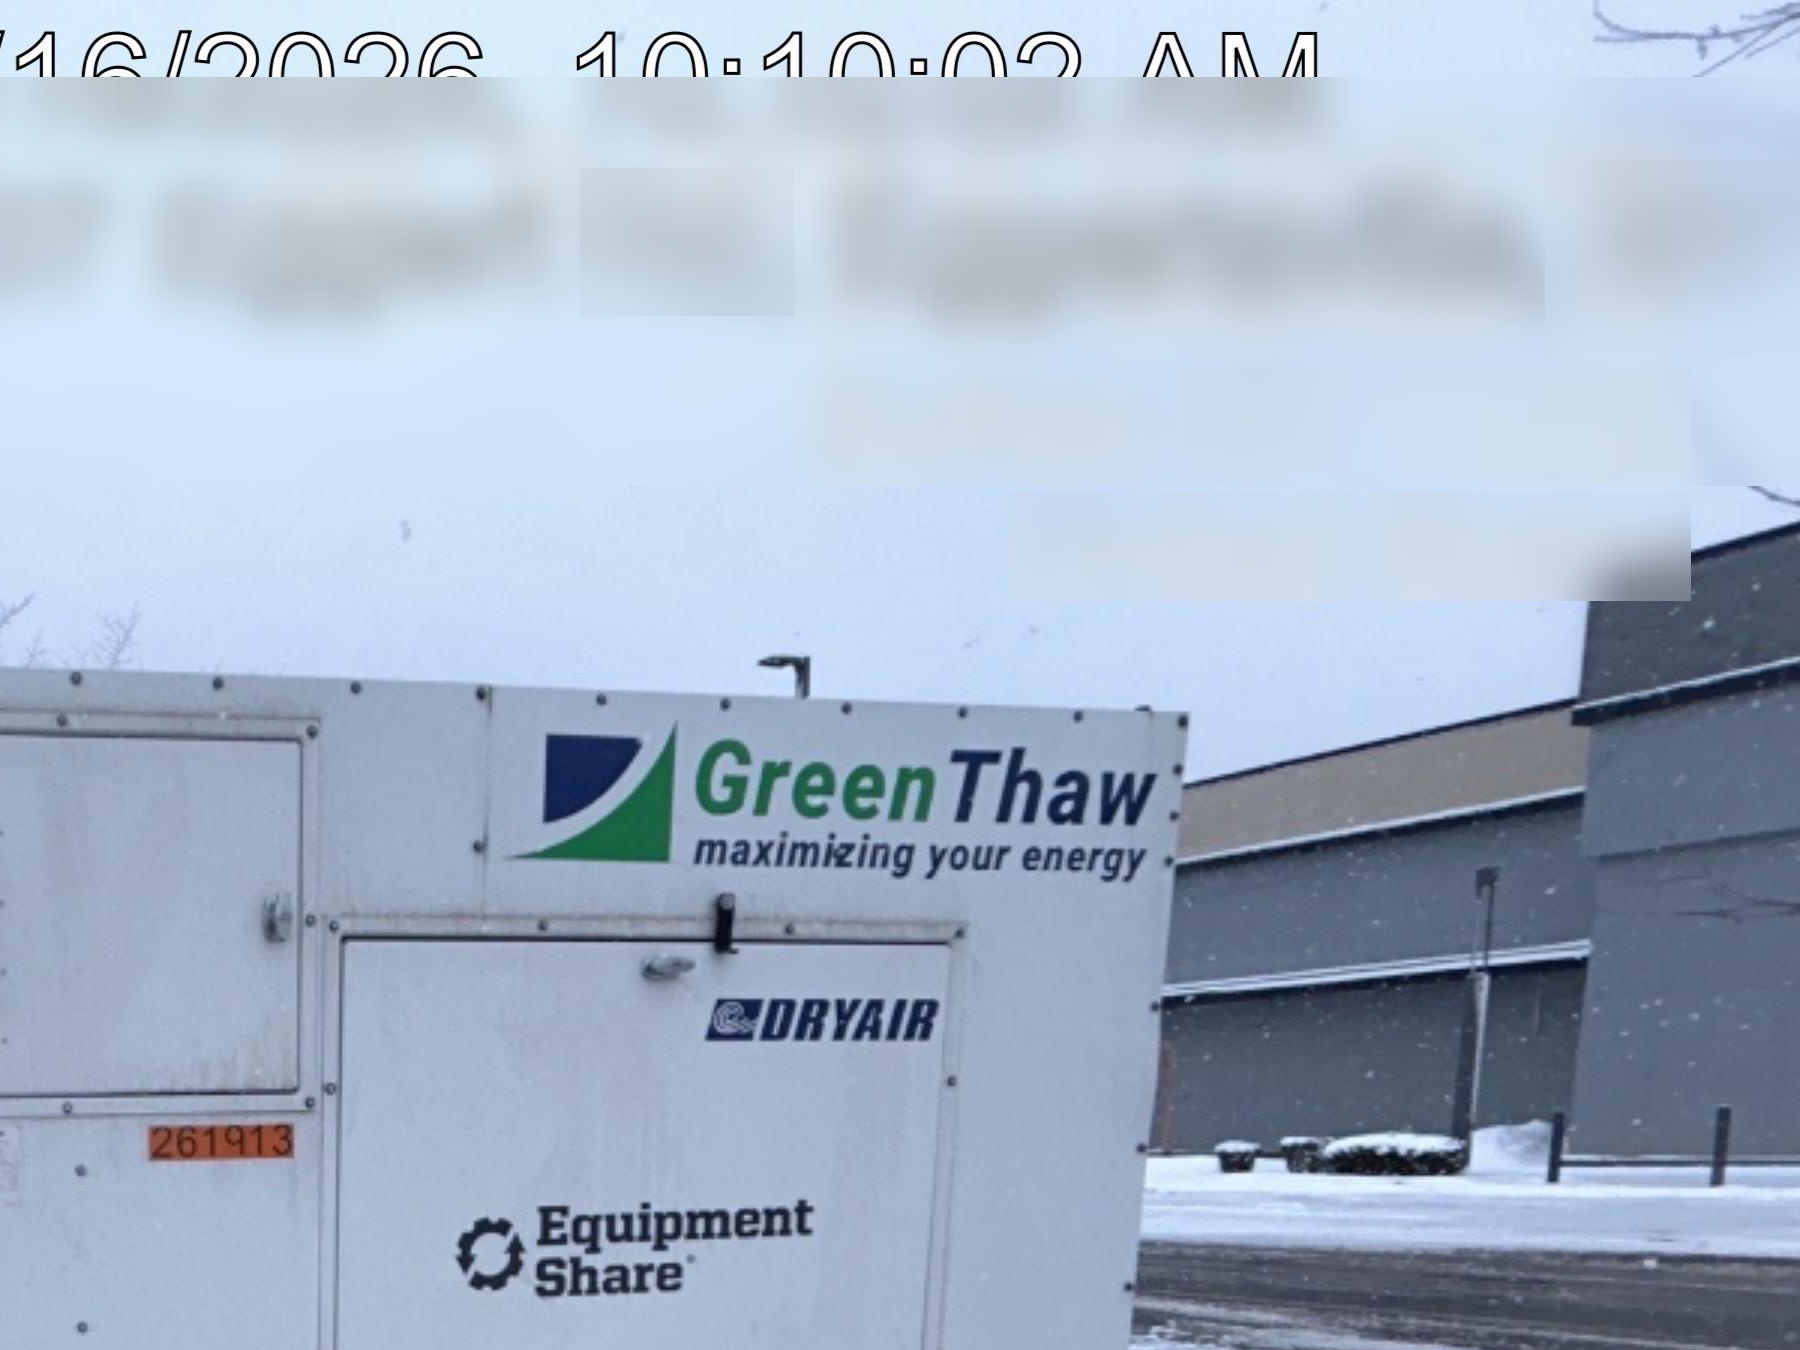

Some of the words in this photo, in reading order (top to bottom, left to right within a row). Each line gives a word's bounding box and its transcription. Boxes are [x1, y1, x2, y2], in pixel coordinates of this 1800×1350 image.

[693, 830, 916, 880] maximizing
[924, 844, 1012, 880] your
[1021, 845, 1148, 883] energy
[759, 997, 940, 1042] DRYAIR
[151, 1124, 293, 1159] 261913
[536, 1199, 814, 1255] Equipment
[535, 1256, 683, 1298] Share
